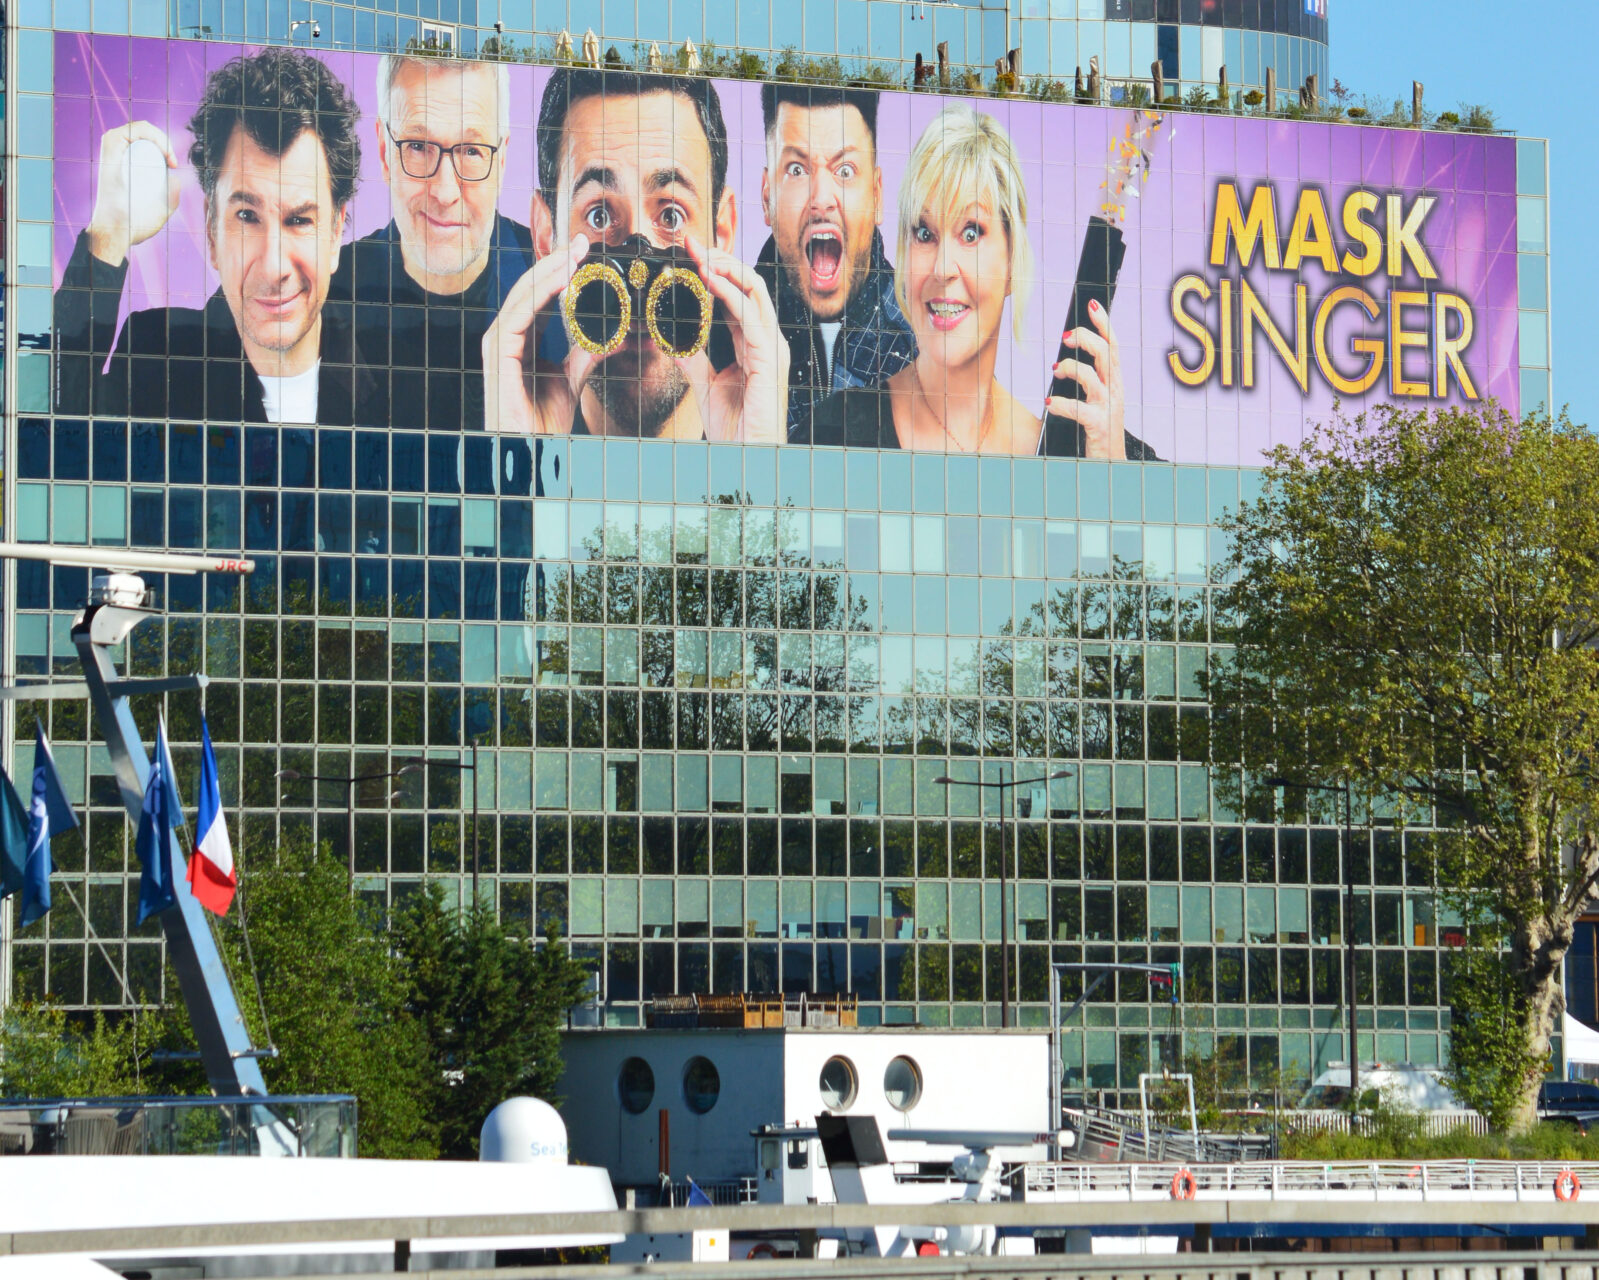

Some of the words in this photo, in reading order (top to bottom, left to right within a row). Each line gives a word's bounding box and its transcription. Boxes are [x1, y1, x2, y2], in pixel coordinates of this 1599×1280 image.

[1210, 183, 1438, 280] MASK
[1168, 274, 1479, 400] SINGER
[215, 560, 248, 572] JRC
[1032, 1132, 1055, 1144] JRC
[530, 1141, 556, 1156] Sea
